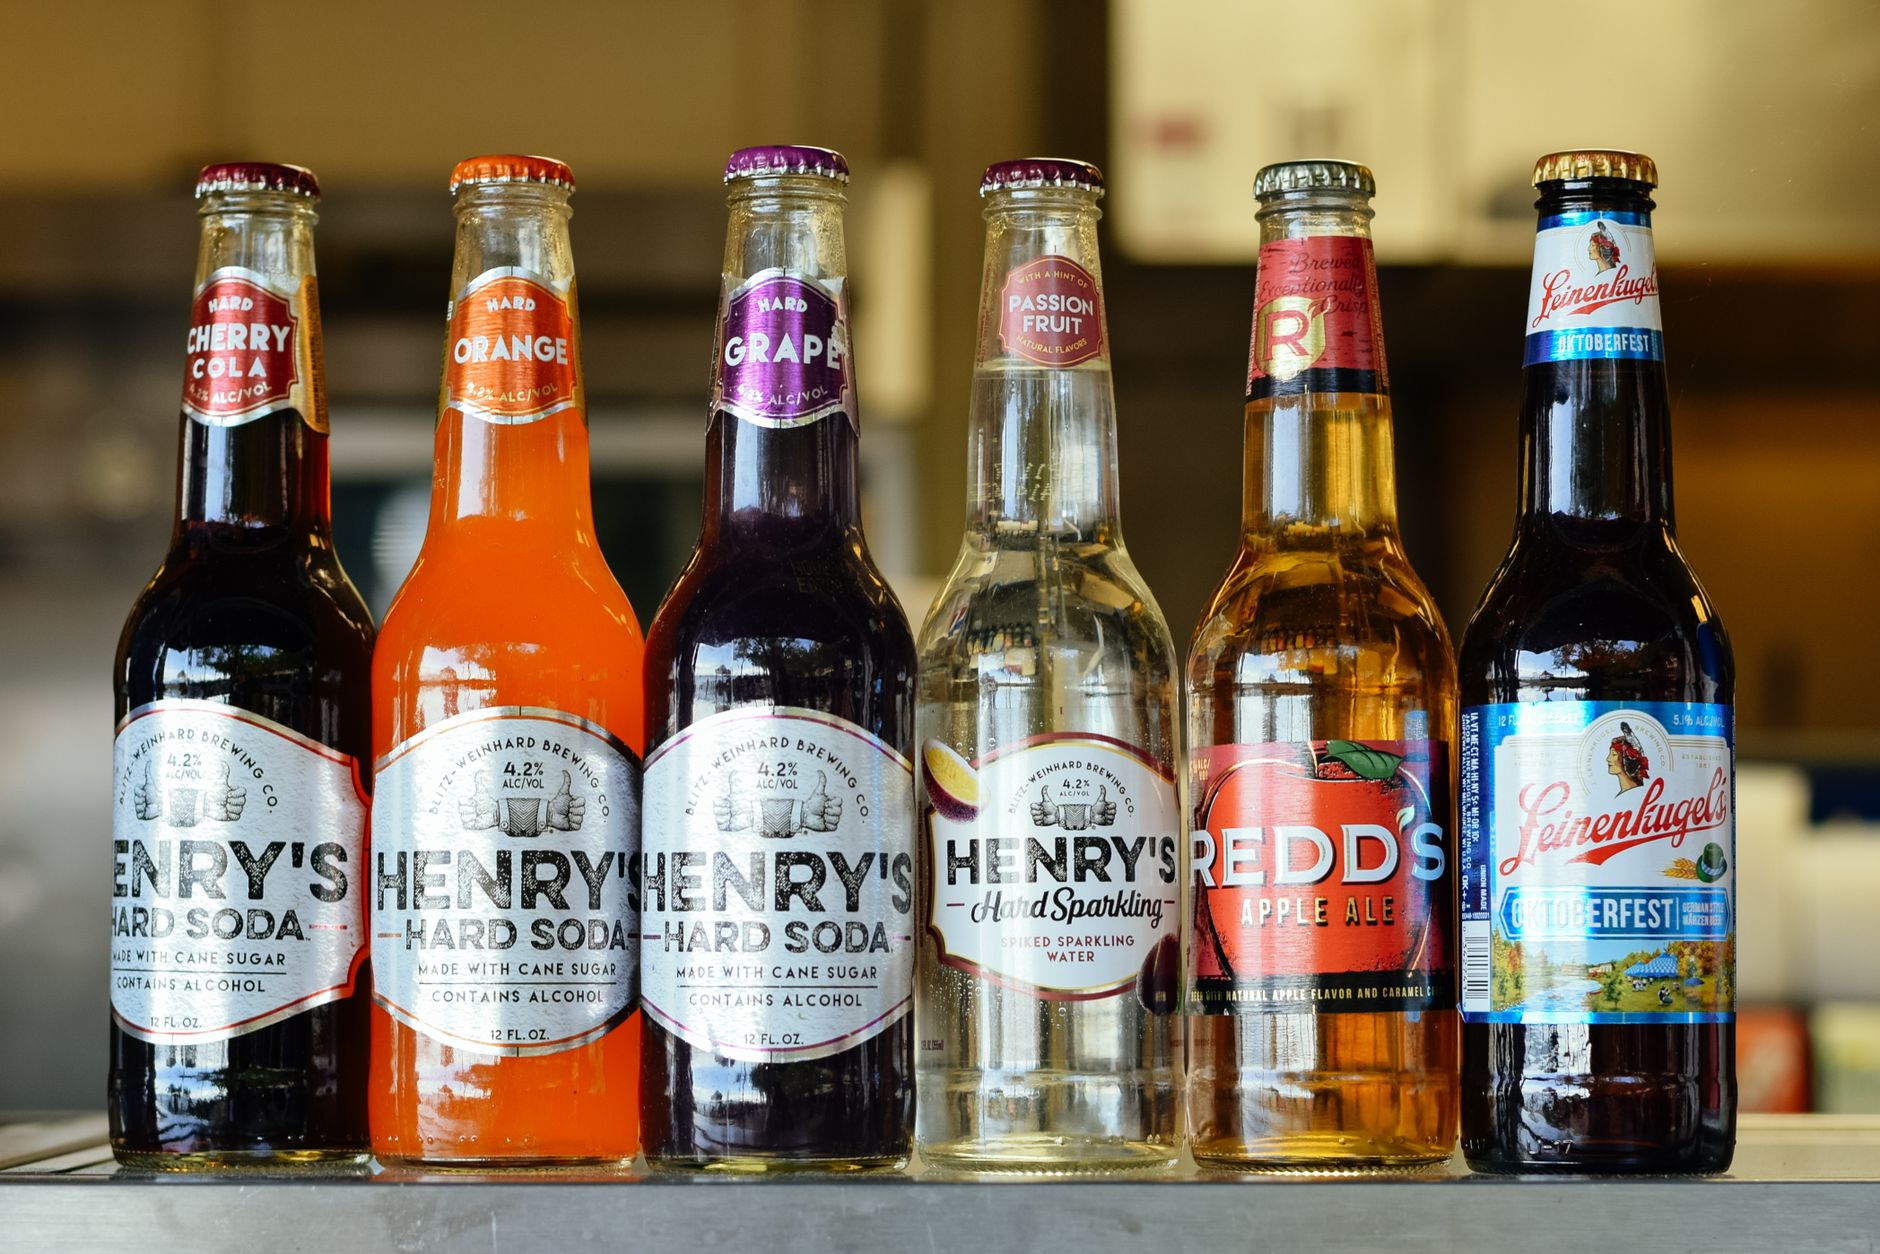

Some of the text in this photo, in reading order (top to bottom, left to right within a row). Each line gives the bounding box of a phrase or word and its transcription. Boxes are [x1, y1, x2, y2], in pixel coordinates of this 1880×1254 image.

[1289, 253, 1361, 274] Brewed
[1053, 271, 1075, 281] HINT
[1077, 279, 1089, 289] OF
[1260, 271, 1366, 298] Exceptionally
[208, 295, 253, 313] HARD
[486, 295, 536, 312] HARD
[758, 296, 808, 313] HARD
[1008, 293, 1094, 316] PASSION
[1321, 294, 1369, 318] Crisp
[1023, 315, 1082, 335] FRUIT
[1263, 309, 1310, 361] R
[187, 322, 290, 354] CHERRY
[1016, 335, 1088, 354] NATURAL FLAVORS
[1558, 332, 1649, 353] OKTOBERFEST
[454, 334, 568, 365] ORANGE
[724, 332, 842, 370] GRAPE
[192, 356, 267, 379] COLA
[212, 381, 272, 403] ALC/VOL
[499, 382, 558, 402] ALC/VOL
[767, 385, 828, 406] ALC/VOL
[167, 753, 202, 767] 4.2%
[504, 761, 544, 777] 4.2%
[757, 761, 799, 777] 4.2%
[201, 730, 264, 779] BREWING
[263, 784, 278, 813] CO.
[428, 736, 610, 823] BLITZ-WEINHARD BREWING CO.
[685, 736, 869, 824] BLITZ-WEINHARD BREWING CO.
[502, 778, 544, 790] ALC/VOL
[756, 777, 799, 791] ALC/VOL
[1062, 779, 1090, 790] 4.2%
[1086, 762, 1126, 795] BREWING
[1124, 797, 1135, 818] CO.
[1499, 767, 1727, 876] Leinenkugel's
[1189, 805, 1446, 888] REDD'S
[113, 838, 348, 903] ENRY'S
[946, 836, 1176, 885] HENRY'S
[377, 849, 641, 912] HENRY'S
[643, 851, 912, 914] HENRY'S
[970, 886, 1163, 929] Hard Sparkling
[1241, 895, 1395, 926] APPLE ALE
[1511, 897, 1673, 929] OKTOBERFEST
[186, 907, 305, 940] SODA
[405, 918, 626, 951] HARD SODA
[664, 920, 890, 953] HARD SODA
[1000, 935, 1135, 949] SPIKED SPARKLING
[136, 950, 168, 963] WITH
[175, 951, 218, 964] CANE
[226, 952, 286, 966] SUGAR
[1047, 950, 1095, 962] WATER
[418, 962, 617, 976] MADE WITH CANE SUGAR
[676, 966, 877, 979] MADE WITH CANE SUGAR
[116, 976, 265, 992] CONTAINS ALCOHOL
[1226, 989, 1268, 1002] NATURAL
[1272, 989, 1306, 1001] APPLE
[1311, 988, 1352, 1000] FLAVOR
[1357, 987, 1378, 999] AND
[1382, 985, 1424, 998] CARAMEL
[432, 989, 603, 1003] CONTAINS ALCOHOL
[689, 993, 863, 1007] CONTAINS ALCOHOL
[150, 1016, 160, 1027] 12
[491, 1029, 502, 1040] 12
[744, 1034, 755, 1045] 12
